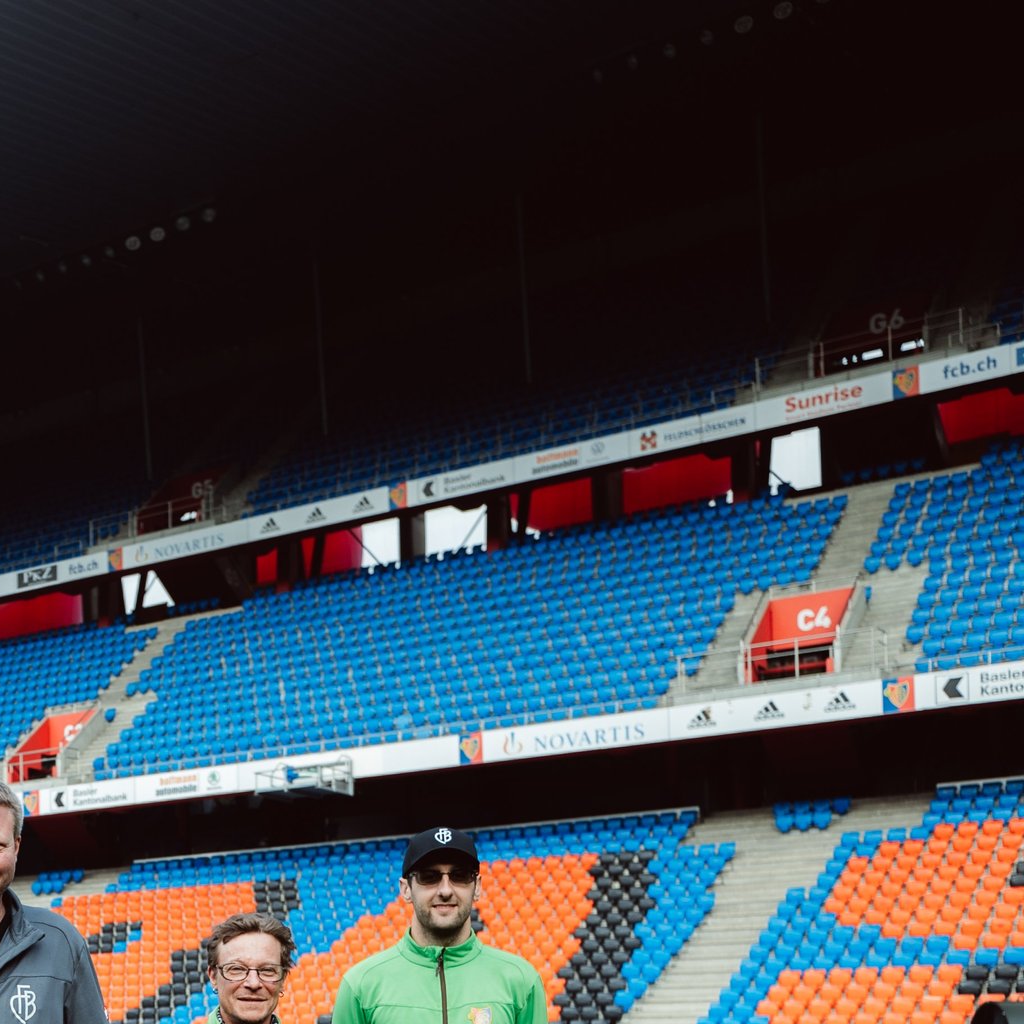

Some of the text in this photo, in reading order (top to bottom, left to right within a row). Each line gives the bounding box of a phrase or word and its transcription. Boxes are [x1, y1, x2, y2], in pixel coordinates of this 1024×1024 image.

[869, 309, 904, 334] G6
[942, 355, 998, 379] fcb.ch
[784, 384, 863, 414] Sunrise
[154, 532, 224, 559] NOVARTIS
[68, 560, 98, 576] fcb.ch
[797, 605, 832, 632] C4
[534, 724, 646, 750] NOVARTIS
[73, 793, 127, 806] Kantonalbank
[155, 783, 197, 798] automobile
